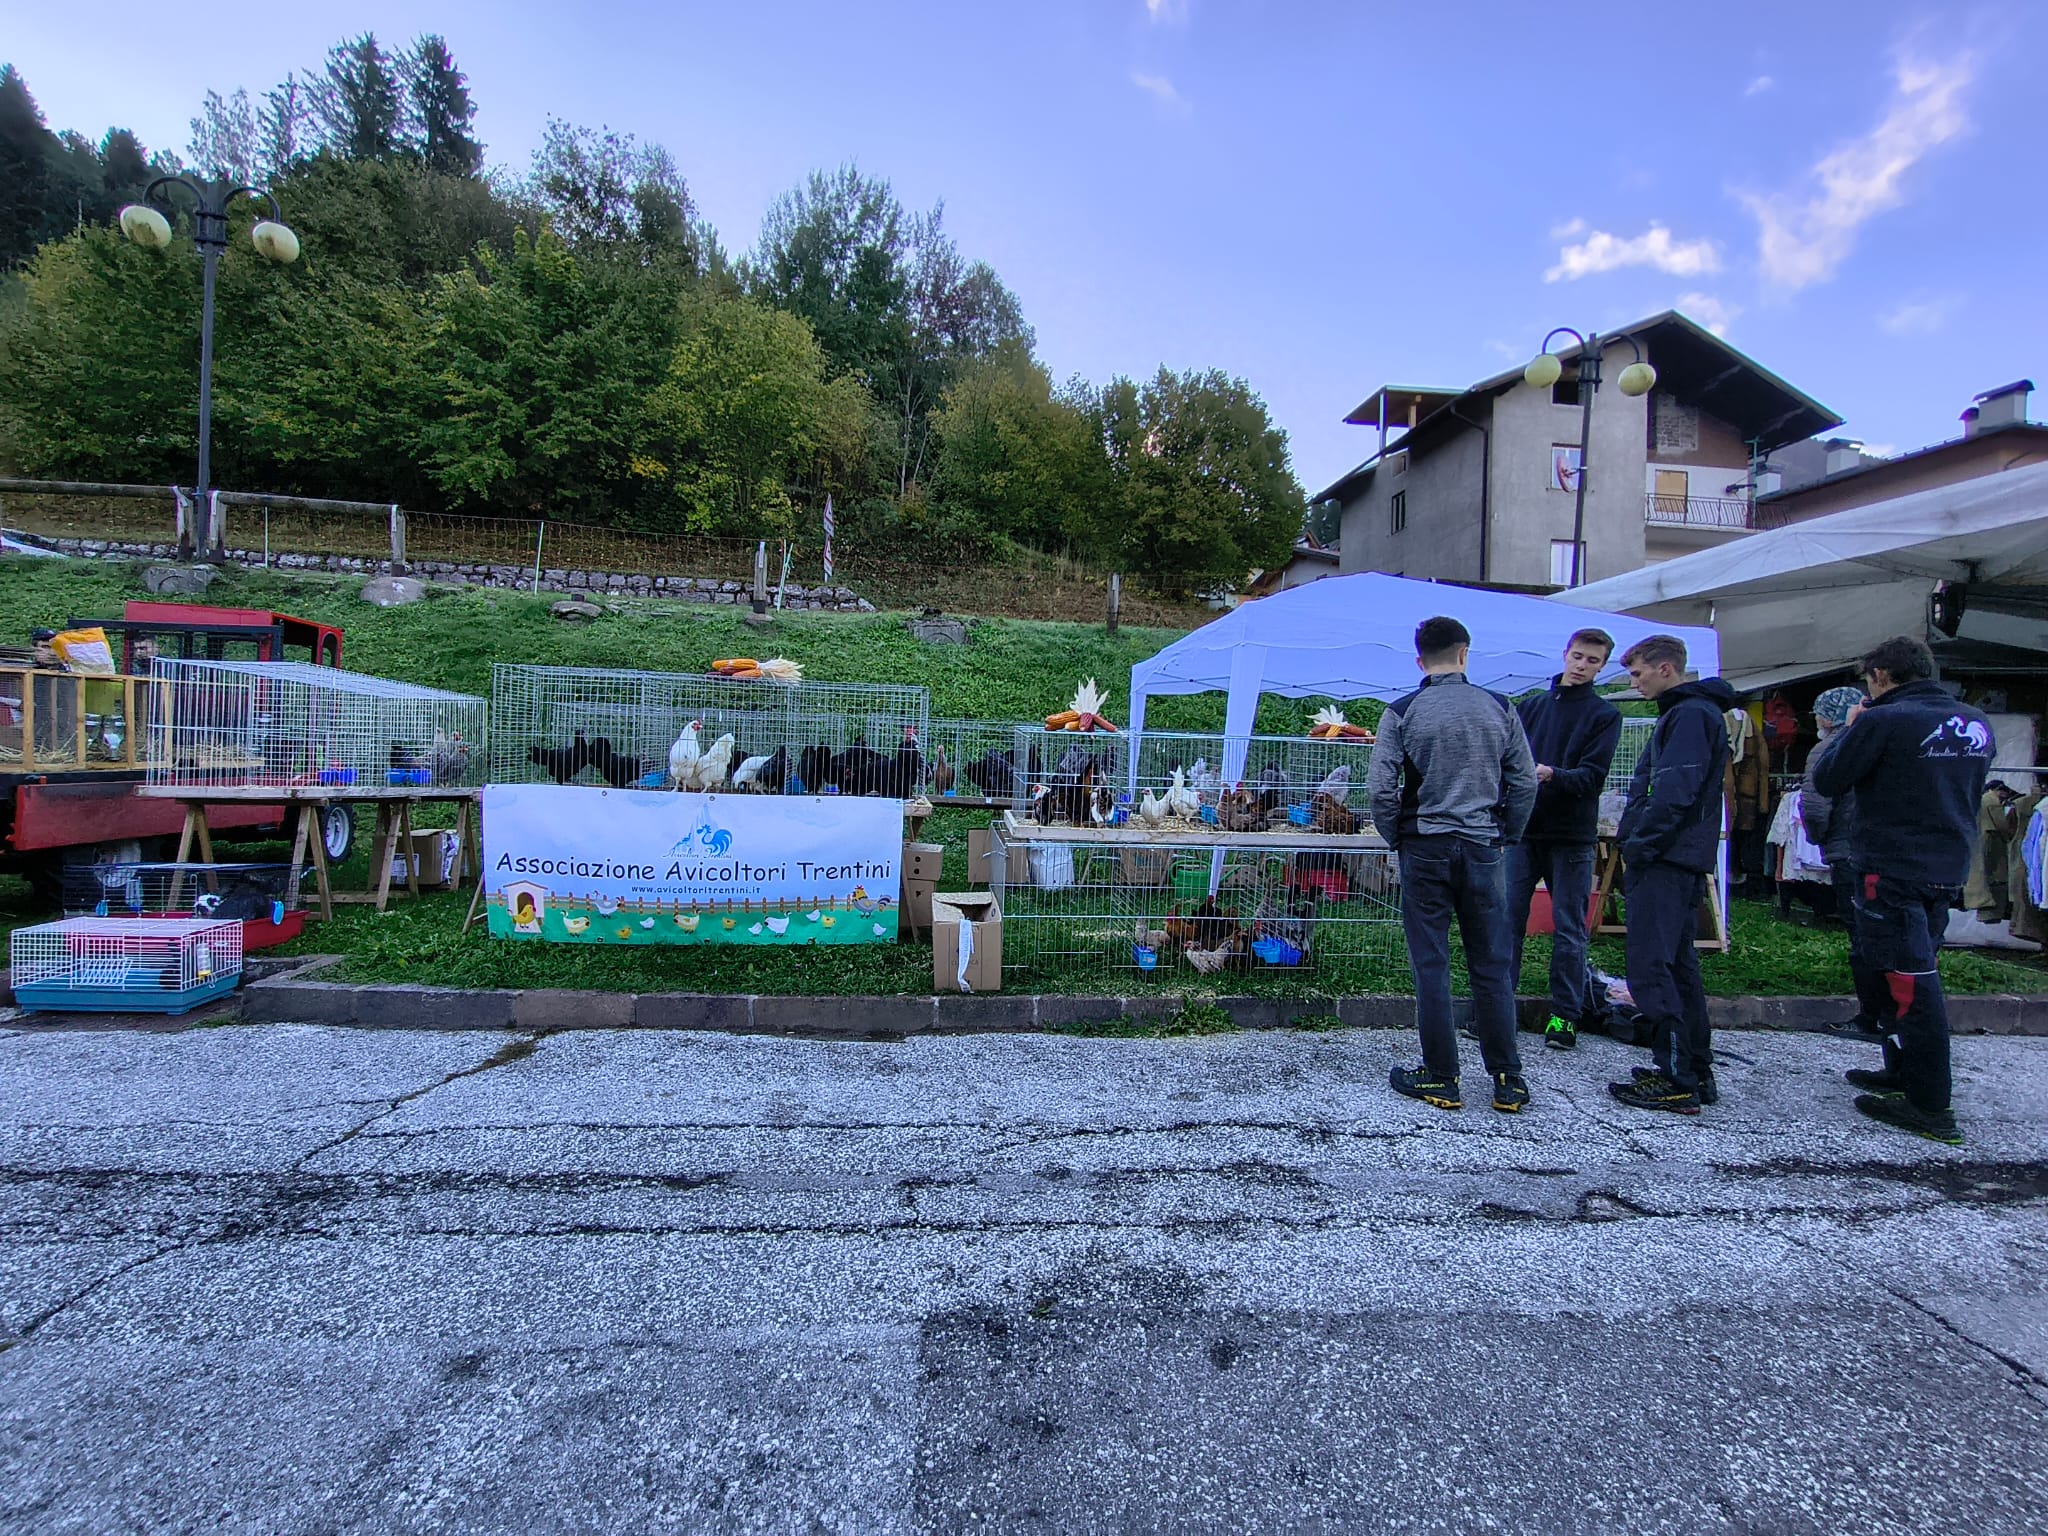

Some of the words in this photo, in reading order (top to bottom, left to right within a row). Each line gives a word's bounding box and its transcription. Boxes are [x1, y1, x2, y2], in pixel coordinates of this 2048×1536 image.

[496, 852, 656, 880] Associazione
[665, 860, 786, 882] Avicoltori
[797, 860, 891, 881] Trentini
[631, 885, 761, 895] www.avicoltoritrentini.it
